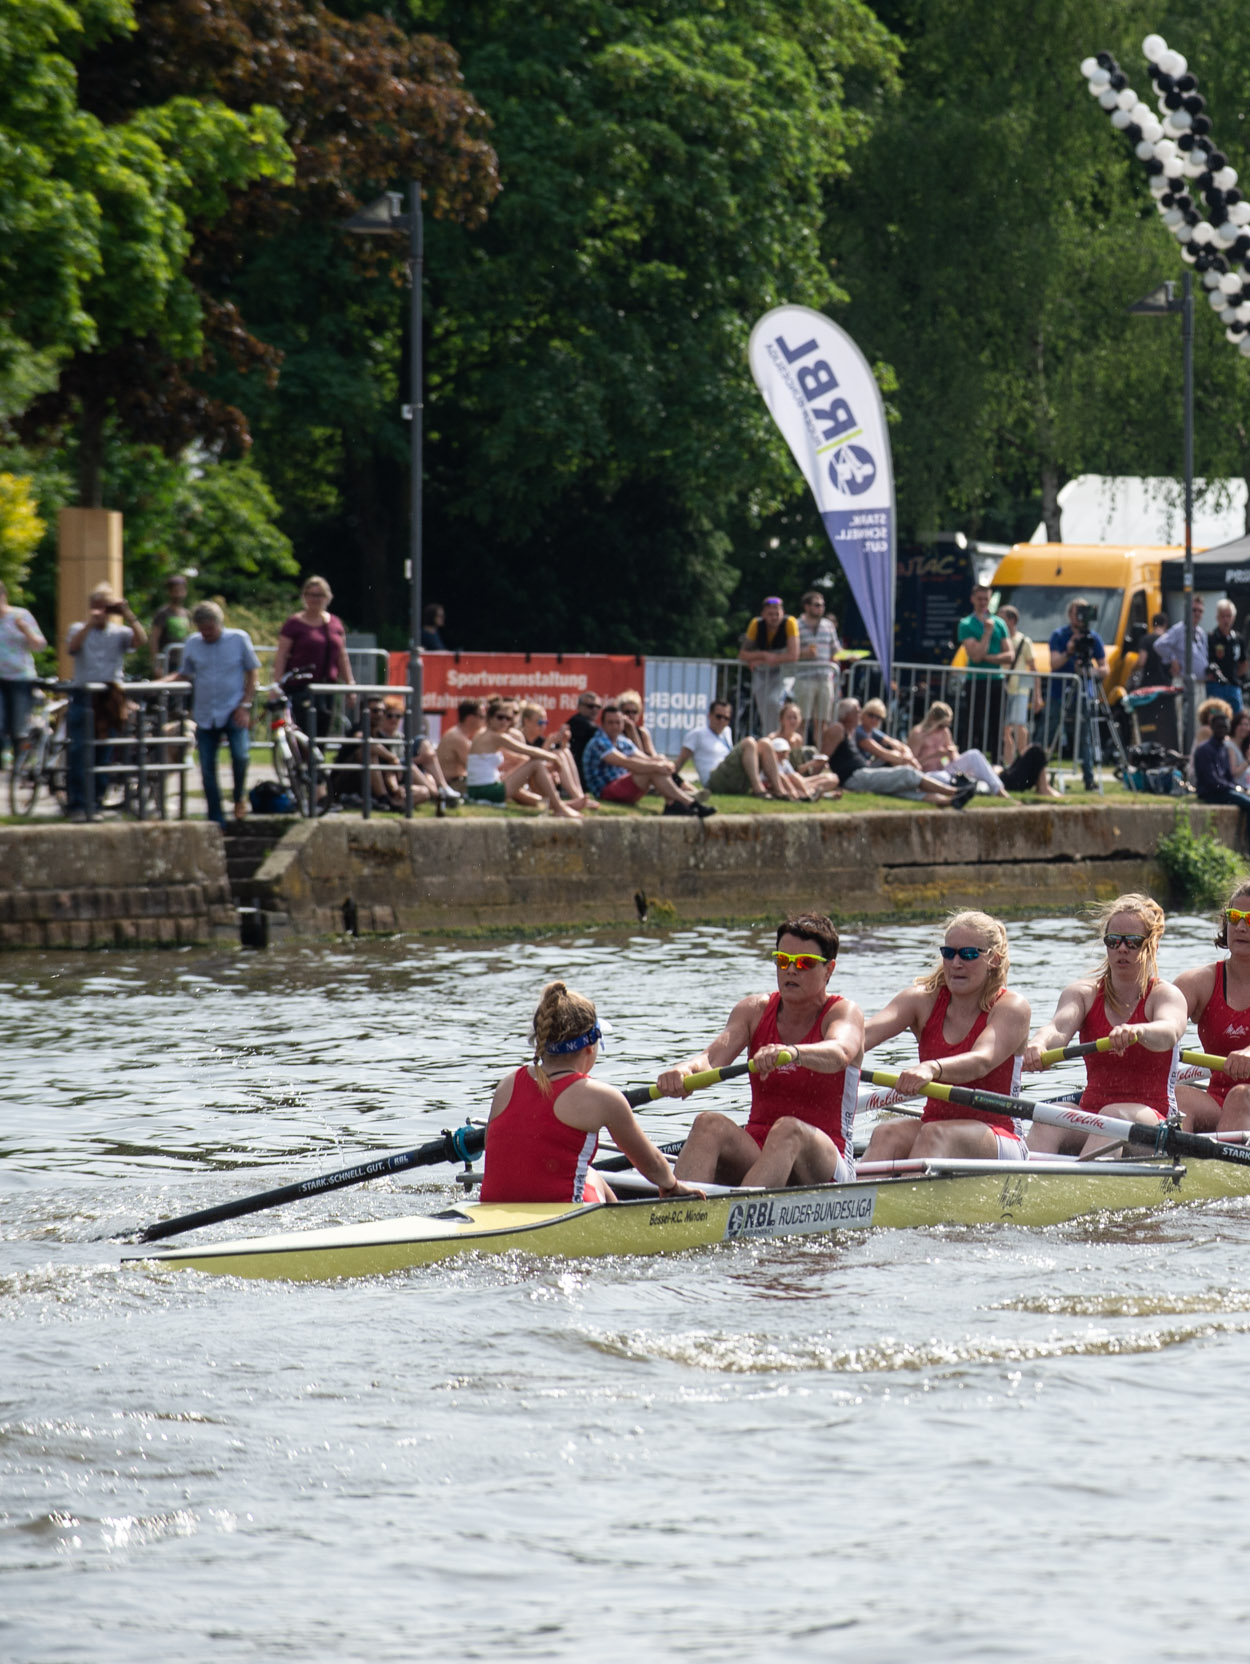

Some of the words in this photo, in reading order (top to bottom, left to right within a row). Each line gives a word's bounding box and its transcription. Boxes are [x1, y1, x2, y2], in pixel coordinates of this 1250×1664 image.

[447, 668, 588, 691] Sportveranstaltung
[866, 1088, 904, 1110] Melitta
[1056, 1110, 1106, 1130] Melitta
[301, 1178, 329, 1193] STARK.
[328, 1168, 366, 1186] SCHNELL.
[366, 1161, 385, 1174] GUT.
[744, 1202, 775, 1229] RBL
[778, 1198, 872, 1226] RUDER-BUNDESLIGA
